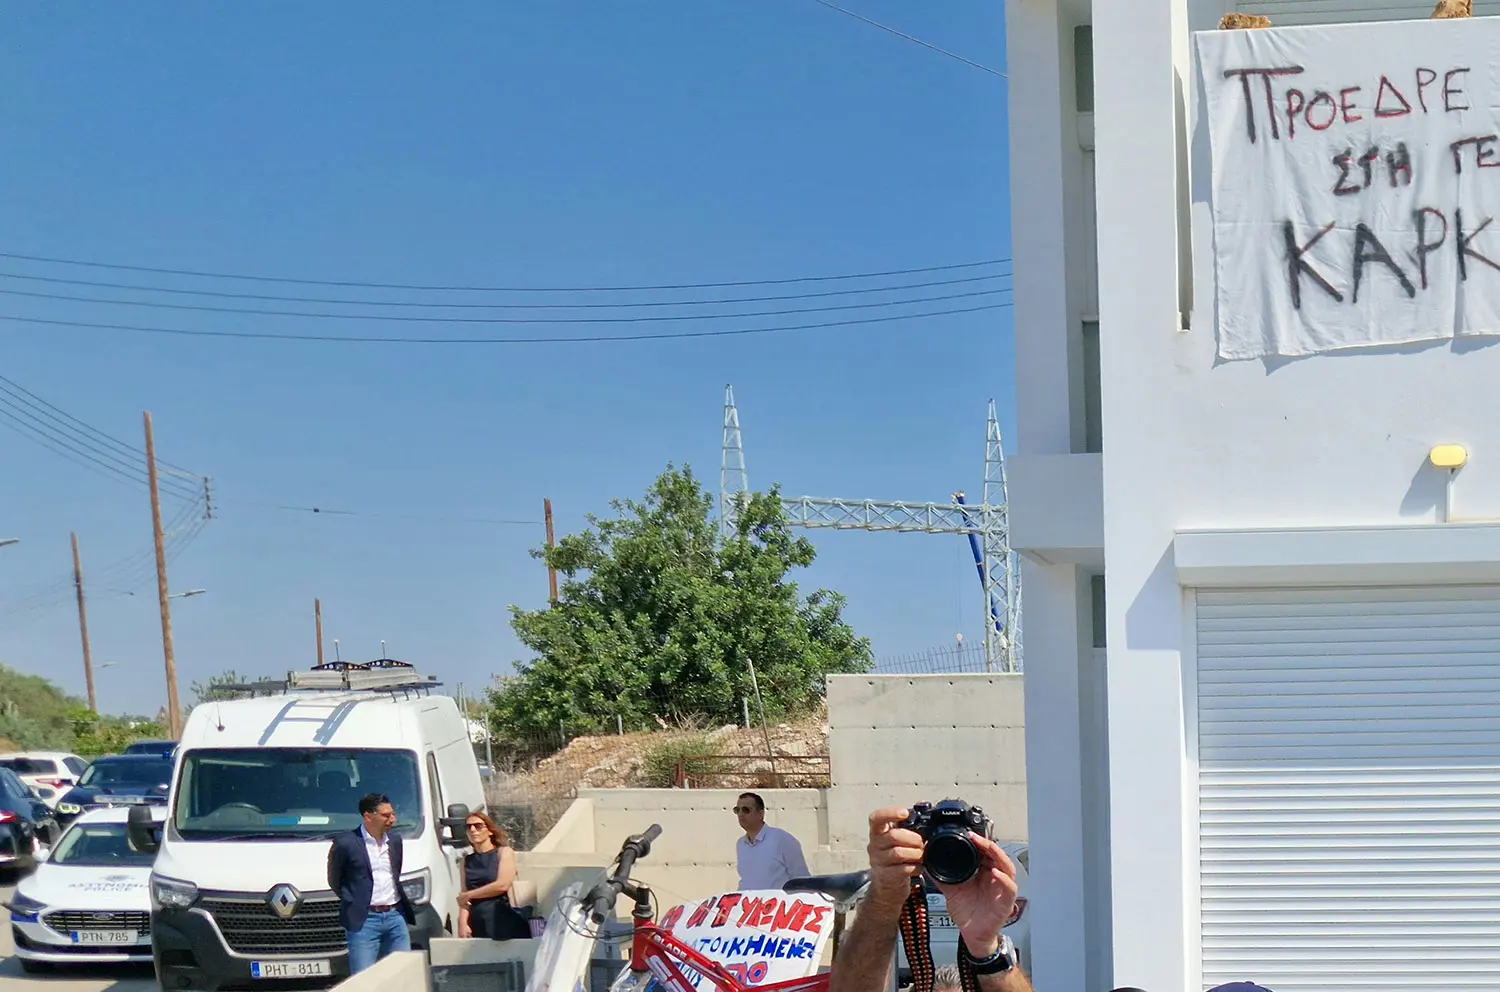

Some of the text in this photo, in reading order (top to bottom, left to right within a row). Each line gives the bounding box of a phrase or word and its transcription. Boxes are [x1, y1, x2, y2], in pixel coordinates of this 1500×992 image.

[1224, 66, 1470, 143] ΠΡΟΕΔΡΕ
[1333, 146, 1412, 196] ΣΤΗ
[264, 964, 288, 976] PHT
